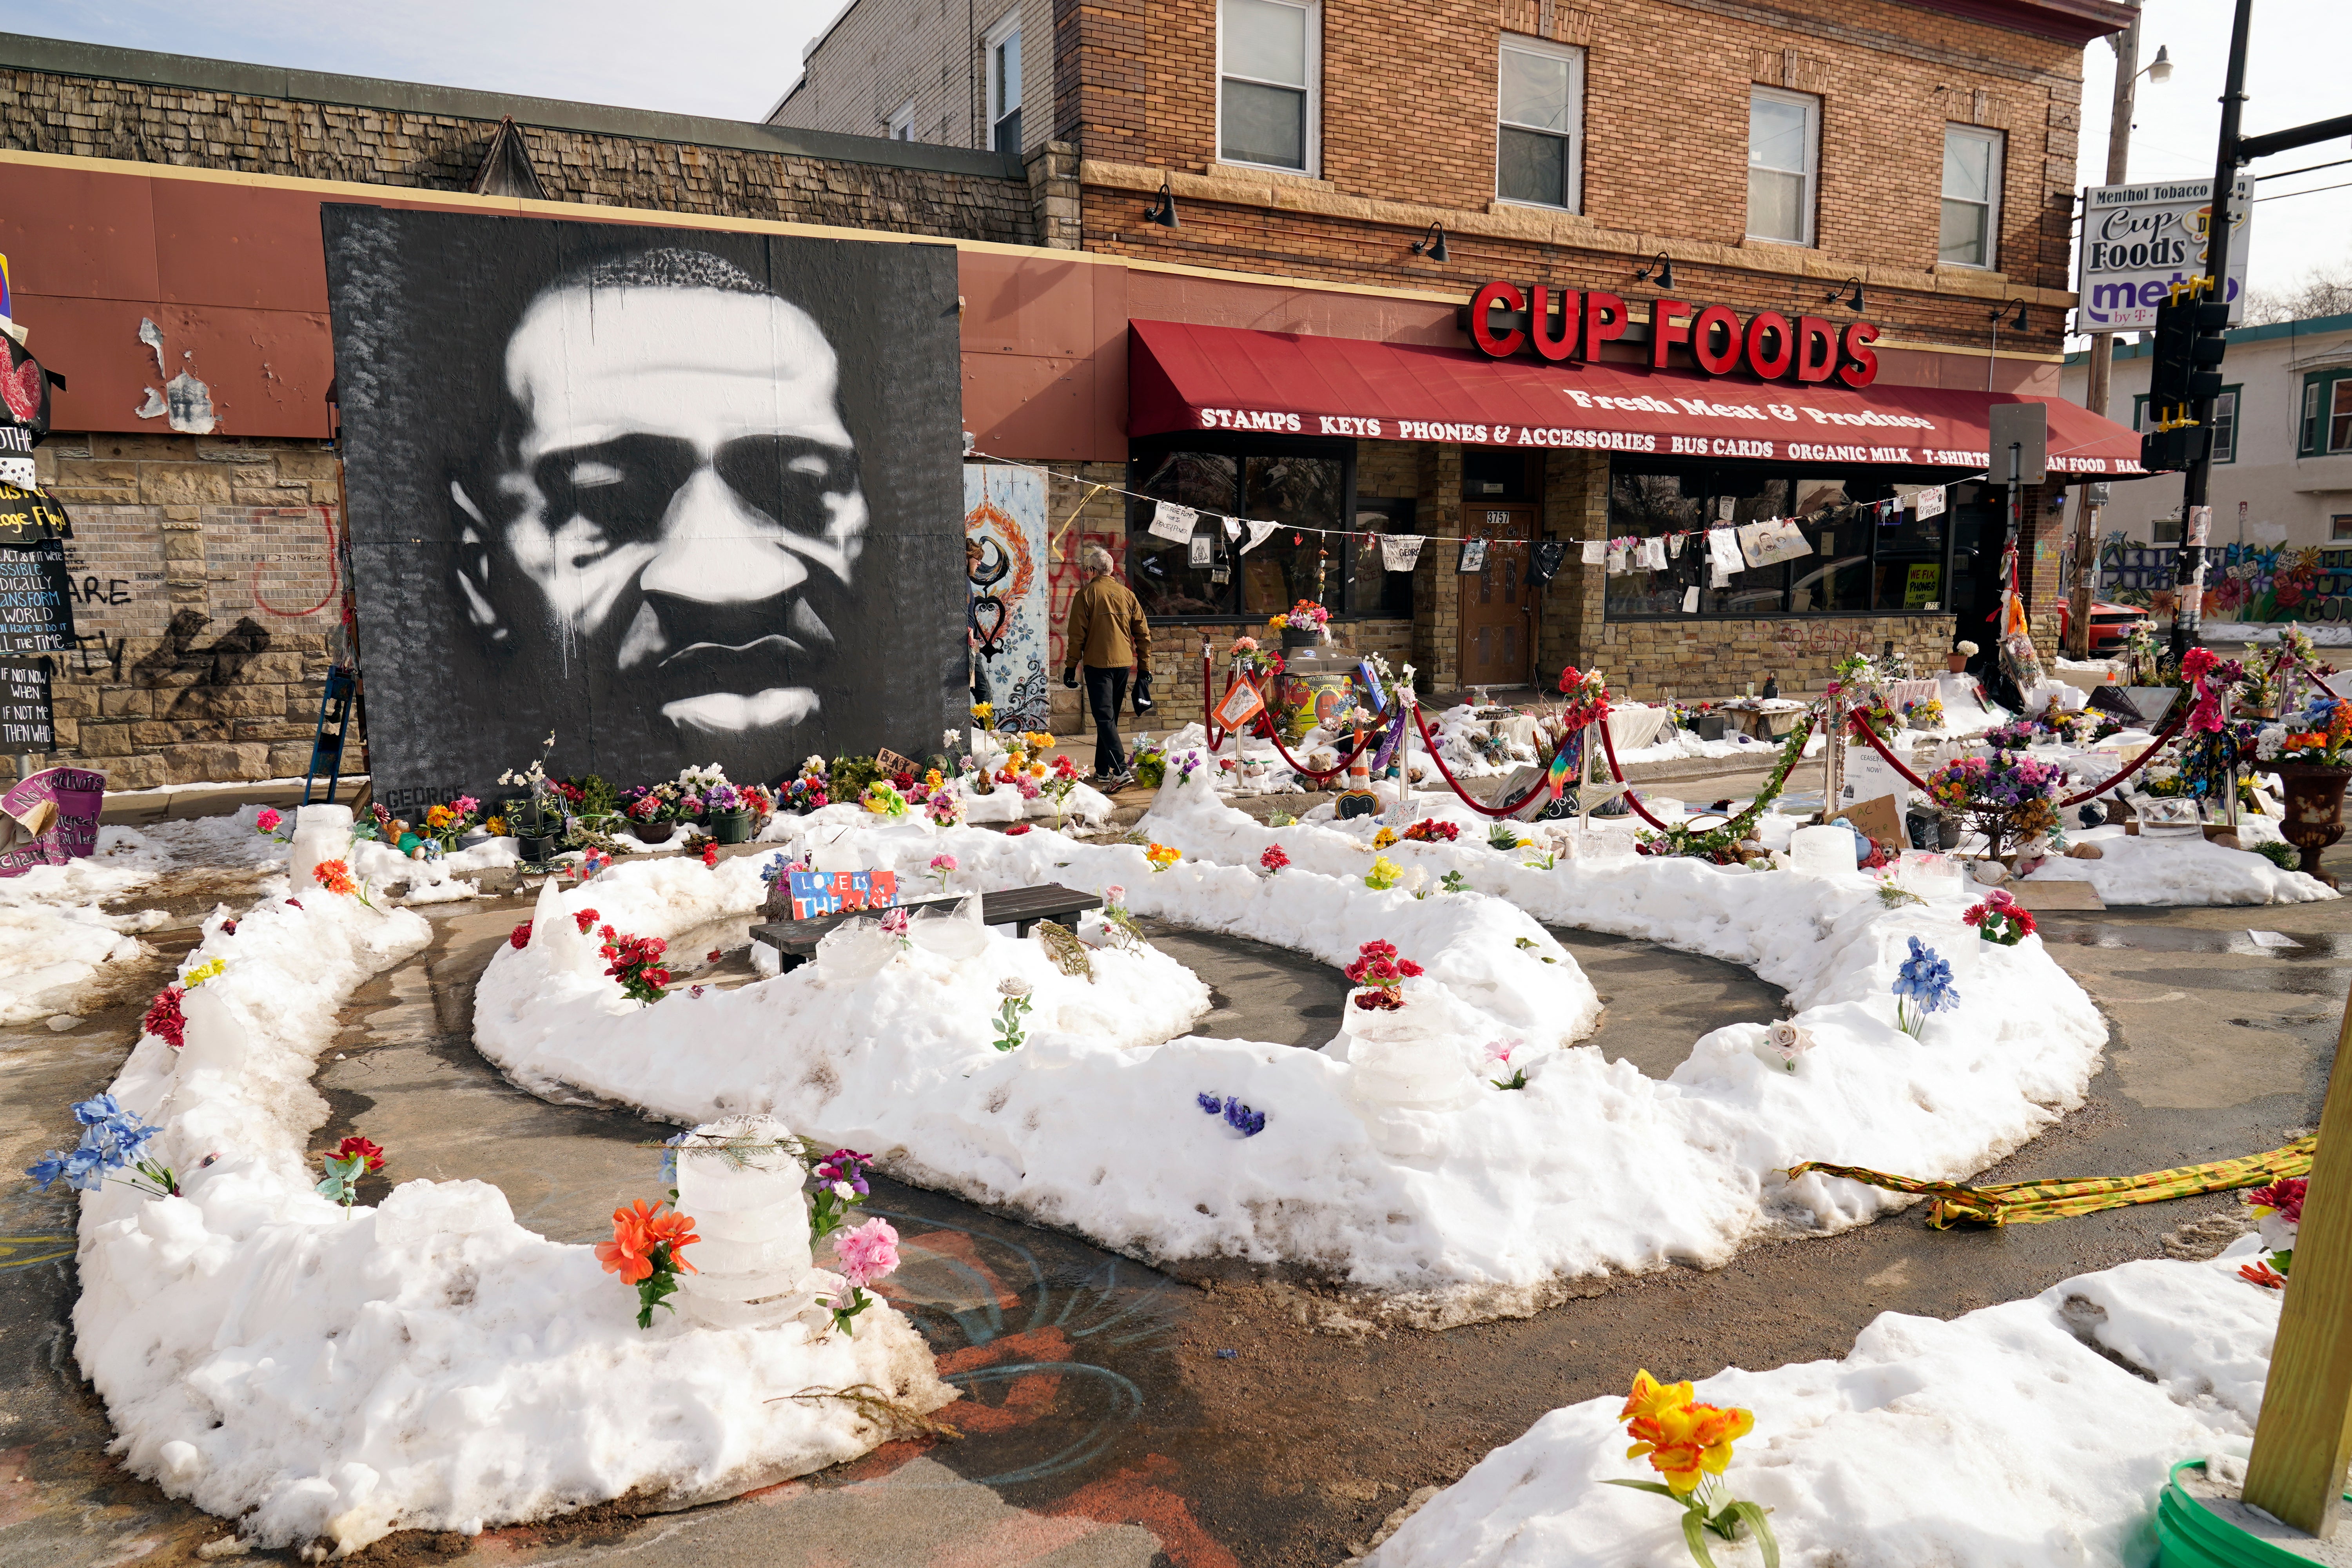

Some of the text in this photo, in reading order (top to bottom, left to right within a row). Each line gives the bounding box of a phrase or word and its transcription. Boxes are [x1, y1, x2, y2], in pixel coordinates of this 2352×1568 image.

[2097, 185, 2207, 204] Menthol Tobacco
[2101, 209, 2182, 243] Cup
[2090, 238, 2185, 269] Foods
[2091, 272, 2238, 310] meto
[2115, 311, 2131, 326] by
[1471, 281, 1880, 388] CUP FOODS
[1563, 389, 1935, 430] Fresh Meat & Produce
[1201, 408, 1301, 431] STAMPS
[1319, 416, 1381, 436] KEYS
[1398, 421, 1488, 442] PHONES
[1493, 425, 1510, 443] &
[1517, 427, 1655, 452] ACCESSORIES
[1671, 436, 1708, 454] BUS
[1713, 439, 1773, 457] CARDS
[1788, 443, 1867, 461] ORGANIC
[1869, 447, 1913, 463] MILK
[1922, 449, 1990, 466] T-SHIRTS
[2046, 456, 2066, 470] AN
[2069, 457, 2106, 472] FOOD
[32, 506, 66, 531] Floyd
[1488, 512, 1508, 523] 3757
[1926, 506, 1940, 516] FLOYD
[29, 551, 36, 562] IF
[37, 551, 43, 562] IT
[2101, 546, 2227, 567] ABOLH
[2282, 550, 2299, 558] BLACK
[1911, 570, 1935, 579] WE FIX
[2100, 570, 2213, 591] POLIE
[1909, 581, 1936, 592] PHONES
[2, 607, 53, 623] WORLD
[45, 624, 57, 632] DO
[1, 668, 47, 684] IF NOT NOW
[3, 706, 11, 720] IF
[14, 706, 33, 720] NOT
[880, 750, 910, 773] BLACK
[1548, 795, 1578, 817] Joy
[802, 874, 868, 890] LOVE IS
[795, 897, 840, 918] THE
